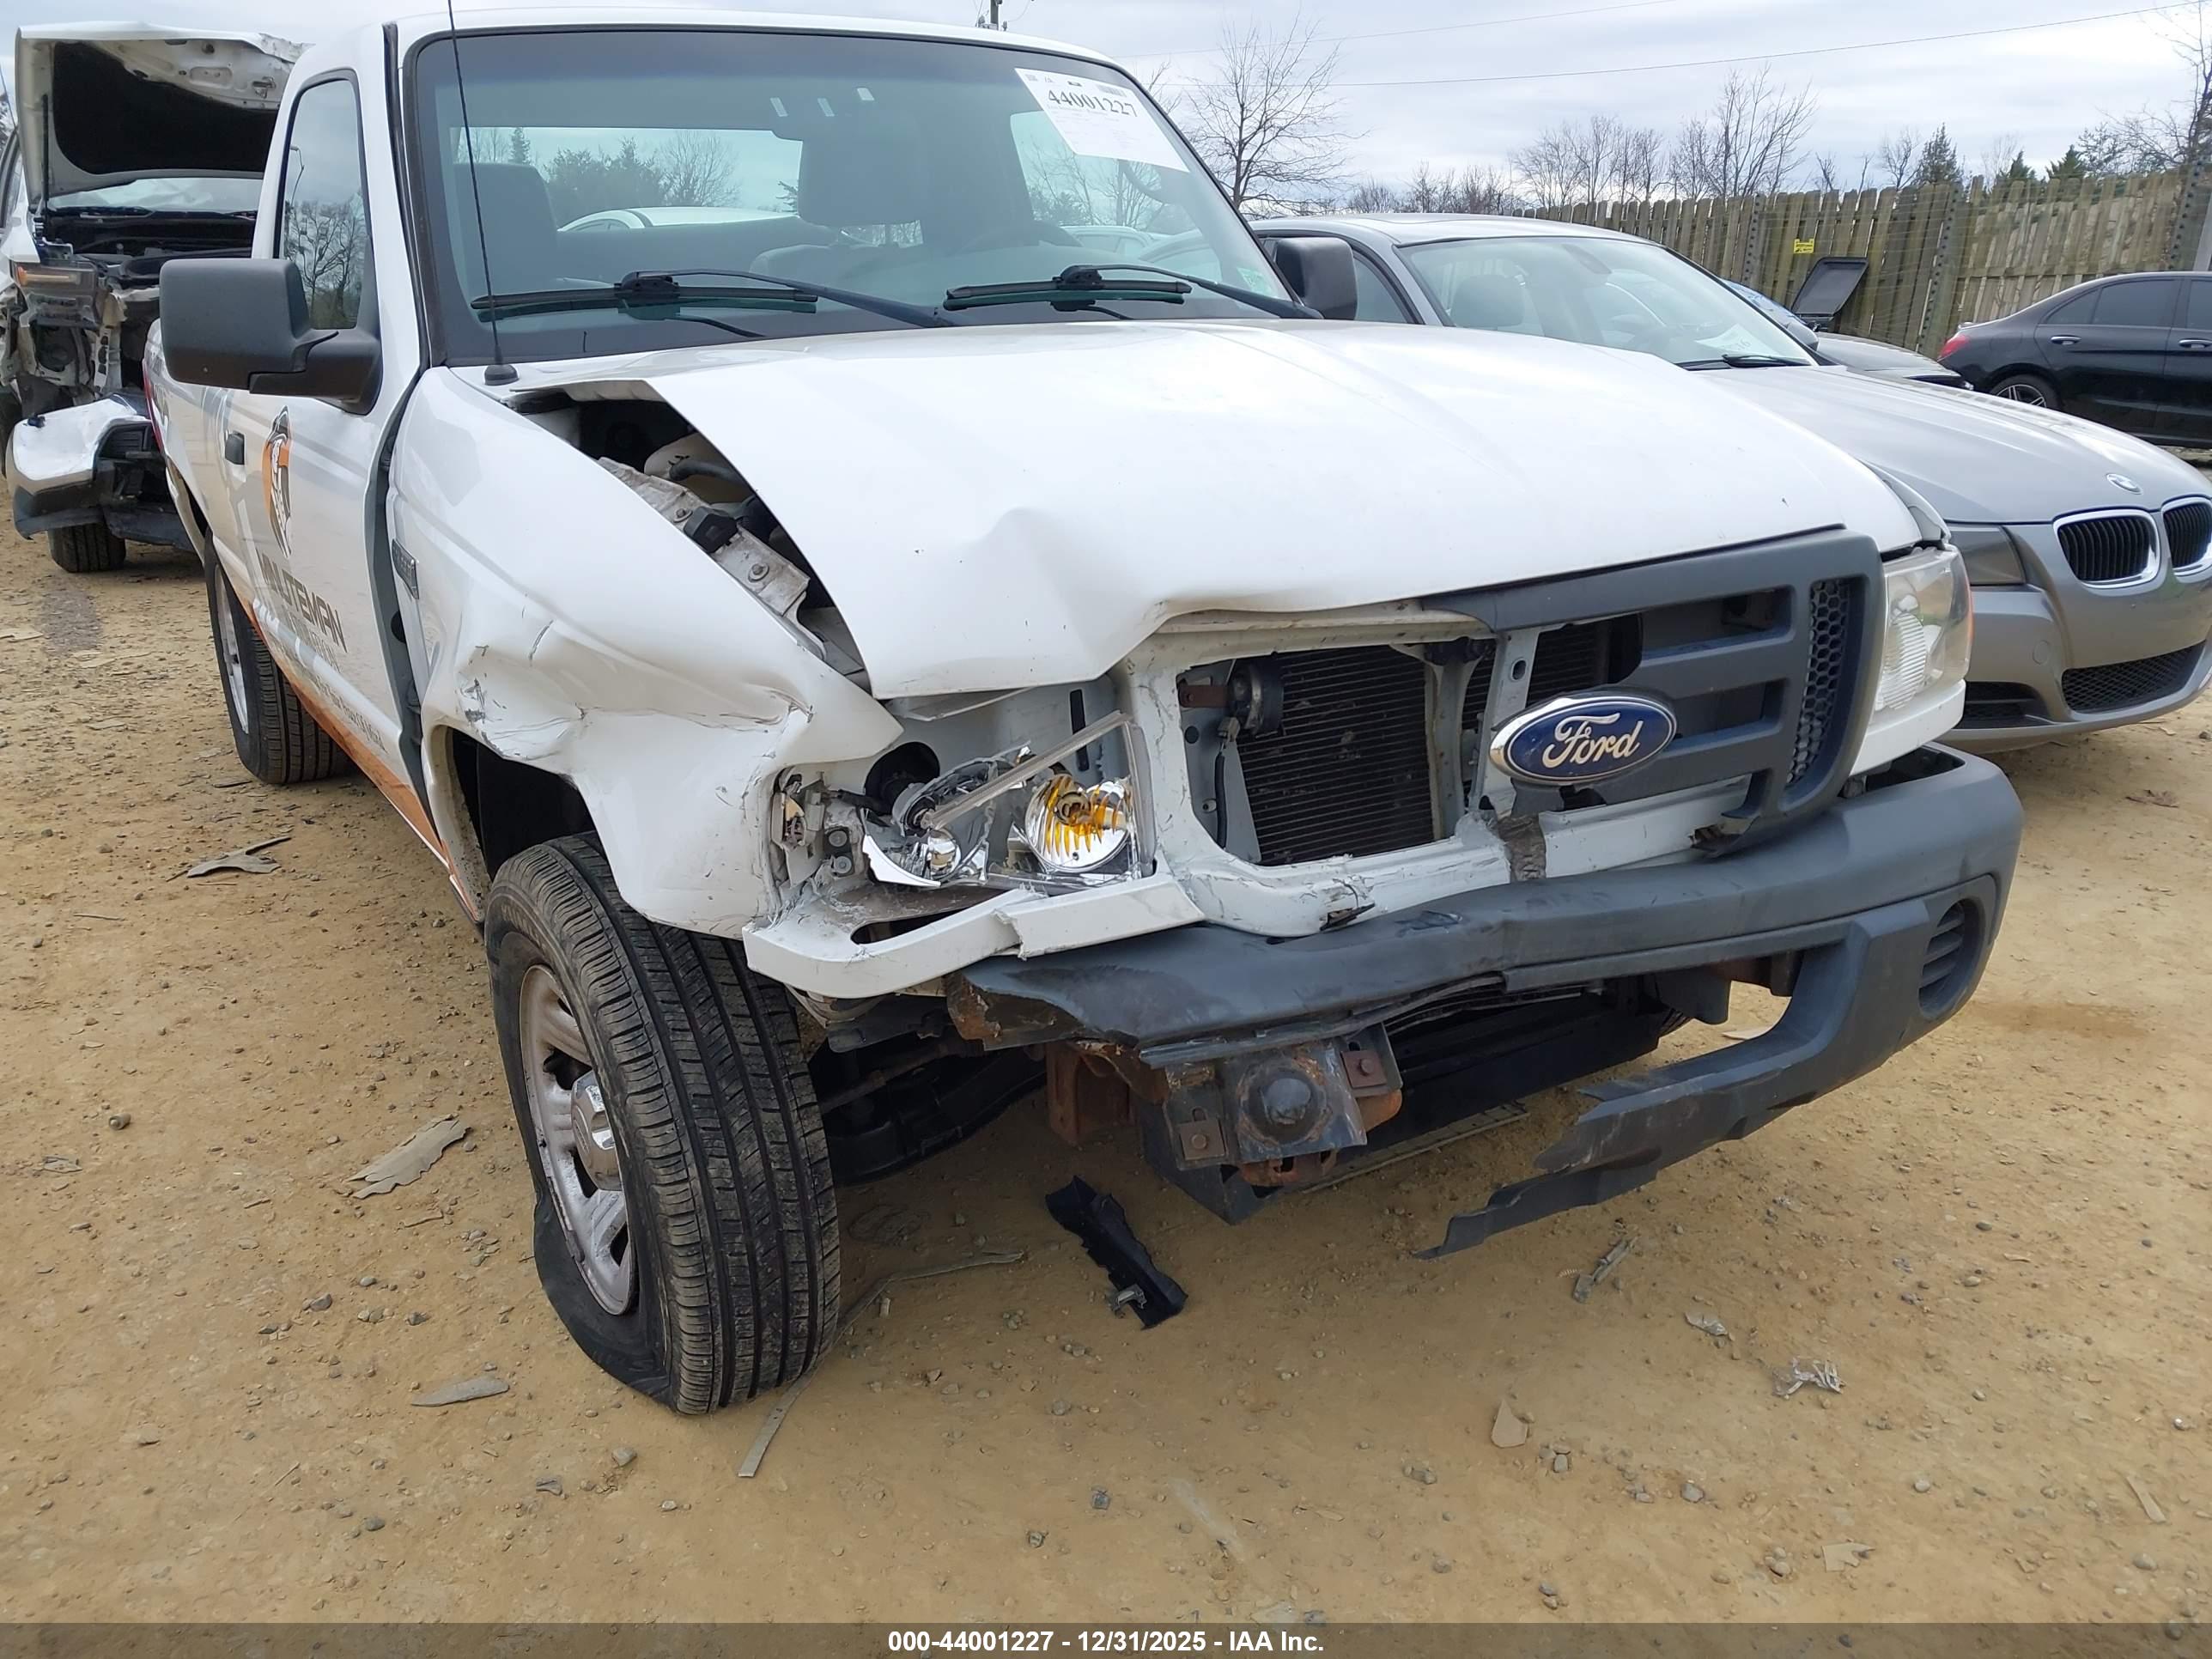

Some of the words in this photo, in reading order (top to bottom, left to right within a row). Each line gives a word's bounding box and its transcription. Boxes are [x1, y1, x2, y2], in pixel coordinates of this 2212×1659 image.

[1048, 89, 1137, 118] 44001227
[255, 546, 348, 653] MUTEMAN
[1542, 713, 1643, 769] Ford
